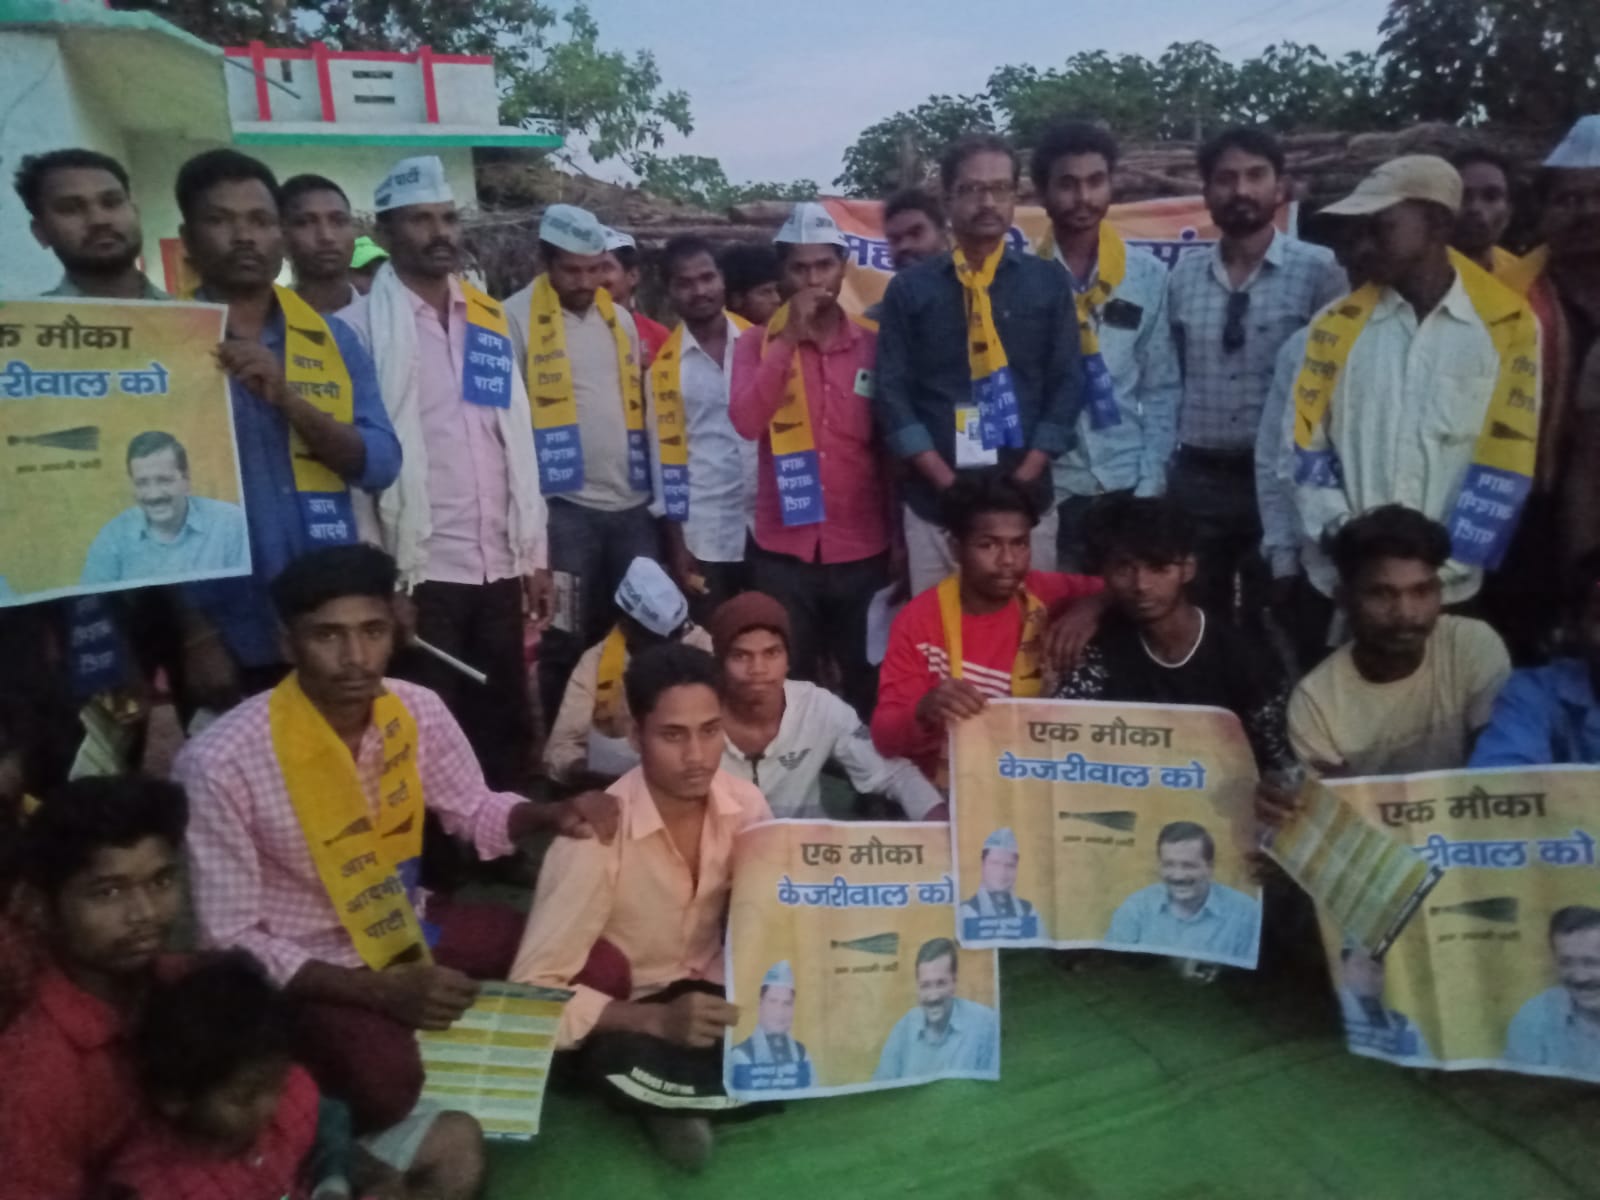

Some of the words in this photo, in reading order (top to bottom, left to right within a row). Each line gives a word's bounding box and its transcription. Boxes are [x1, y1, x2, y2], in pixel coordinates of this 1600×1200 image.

[37, 314, 132, 349] मौका
[118, 363, 168, 394] को
[1028, 721, 1082, 743] एक
[1091, 716, 1174, 748] मौका
[998, 752, 1153, 789] केजरीवाल
[1160, 760, 1207, 790] को
[1377, 799, 1437, 827] एक
[1446, 786, 1547, 819] मौका
[801, 843, 843, 867] एक
[850, 836, 924, 866] मौका
[1537, 828, 1596, 866] को
[346, 874, 408, 914] आदमी
[776, 875, 910, 907] केजरीवाल
[916, 876, 955, 905] को
[363, 907, 408, 940] पार्टी
